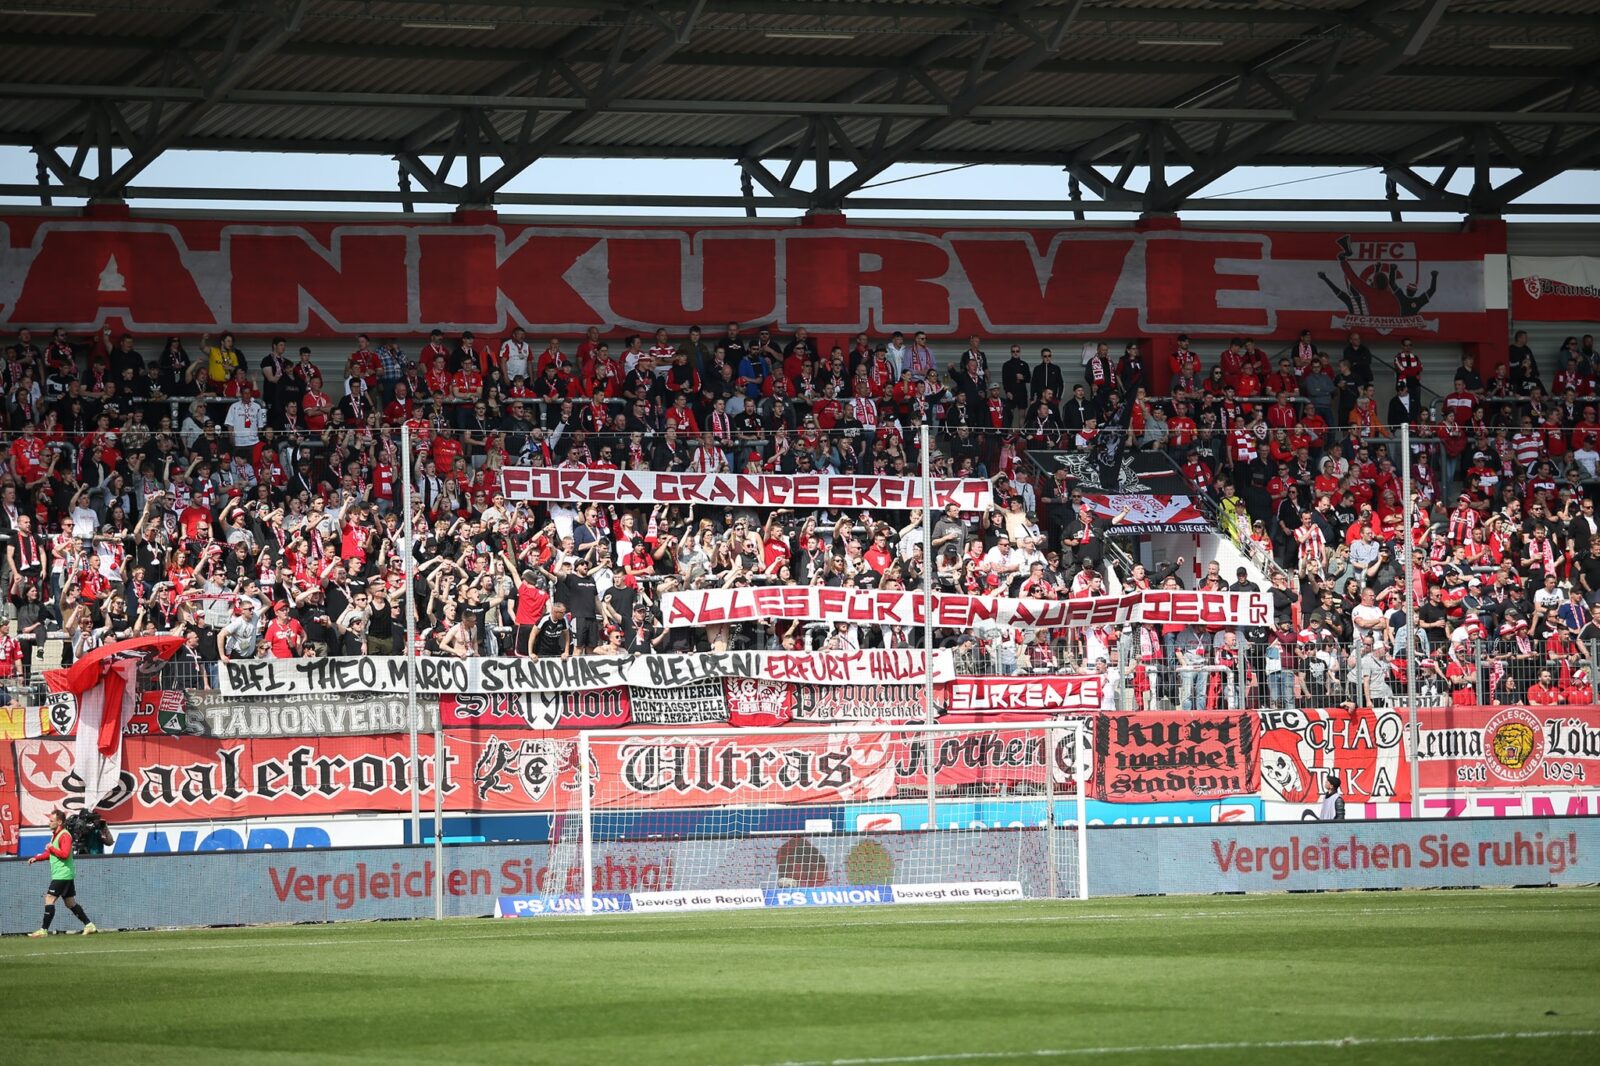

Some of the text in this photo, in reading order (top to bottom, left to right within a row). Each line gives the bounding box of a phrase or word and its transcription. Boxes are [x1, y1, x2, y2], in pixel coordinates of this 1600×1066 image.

[1358, 242, 1404, 260] HFC
[0, 222, 1278, 334] ANKURVE
[502, 468, 989, 508] FORZA GRANDE ERFURT
[668, 588, 1239, 626] ALLES FÜR DEN AUFSTIEG!
[297, 656, 386, 690] THEO,
[481, 655, 636, 691] STANDHAFT
[48, 693, 69, 705] HFC
[630, 684, 722, 700] BOYKOTTIEREN
[951, 680, 1099, 709] SURREALE
[632, 699, 724, 713] MONTAGSSPIELE
[634, 711, 726, 724] NICHT AKZEPTIEREN
[818, 703, 923, 718] ist Leidenschaft
[1109, 713, 1241, 748] kurt
[1487, 710, 1541, 735] HALLESCHER
[619, 738, 853, 794] Ultras
[1458, 761, 1586, 782] seit 1984
[1484, 743, 1539, 780] FUSSBALLCLUB
[1211, 831, 1578, 881] Vergleichen Sie ruhig!
[268, 860, 492, 909] Vergleichen
[501, 858, 550, 895] Sie
[896, 886, 1020, 899] bewegt die Region
[515, 897, 619, 913] PS UNON
[636, 892, 763, 908] bewegt die Region
[777, 889, 882, 905] PS UNION
